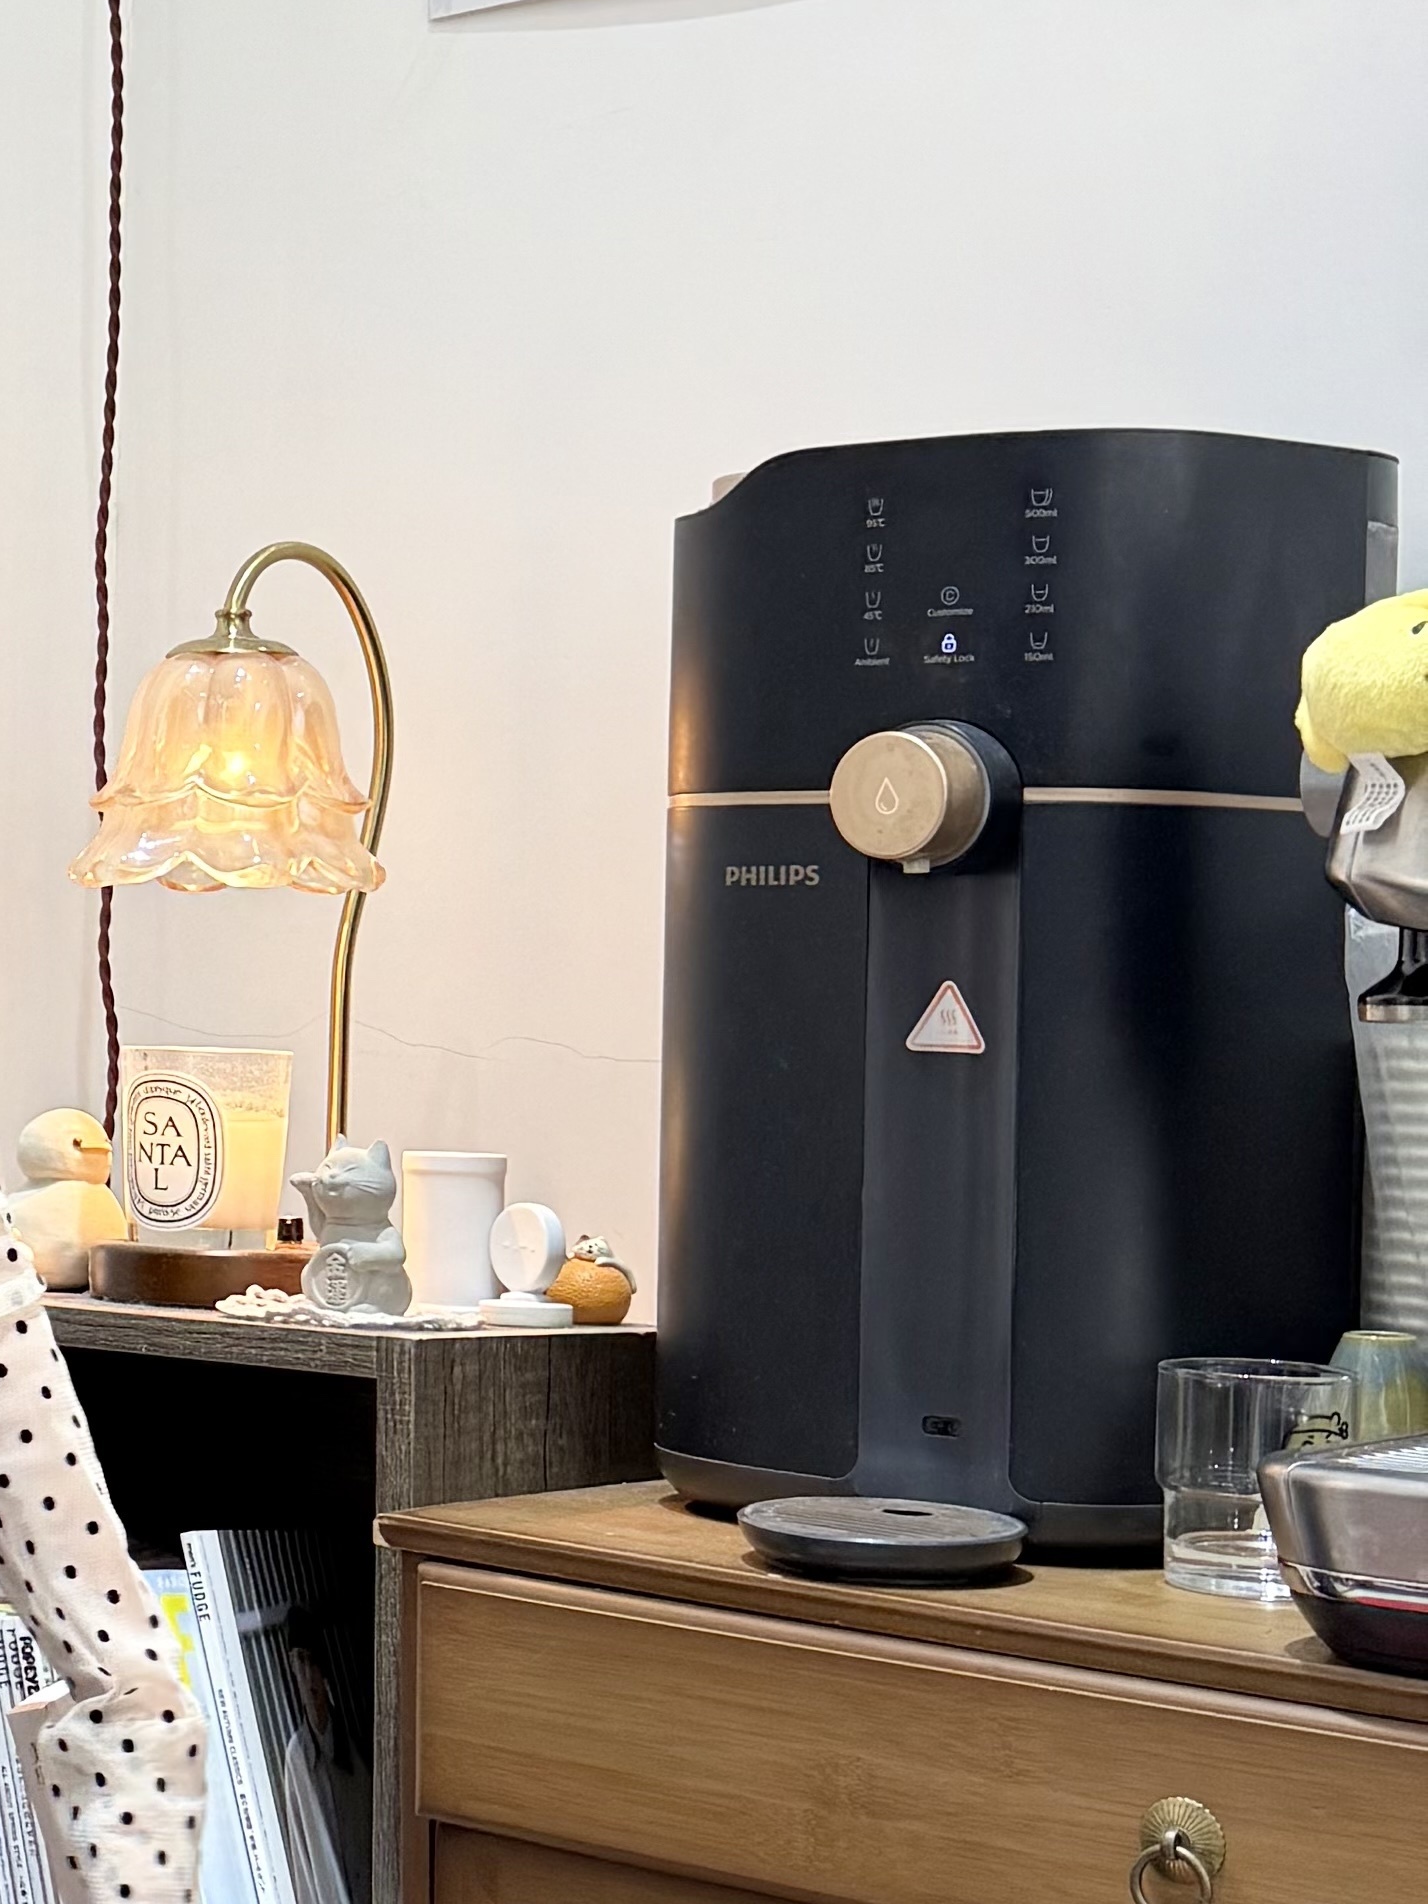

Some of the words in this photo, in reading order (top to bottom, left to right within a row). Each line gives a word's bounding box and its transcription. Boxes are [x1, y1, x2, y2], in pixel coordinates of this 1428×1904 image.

[953, 654, 975, 663] Lock
[725, 864, 820, 886] PHILIPS
[143, 1111, 183, 1138] SA
[138, 1141, 192, 1167] NTA
[153, 1168, 169, 1191] L
[190, 1571, 211, 1622] FUDGE
